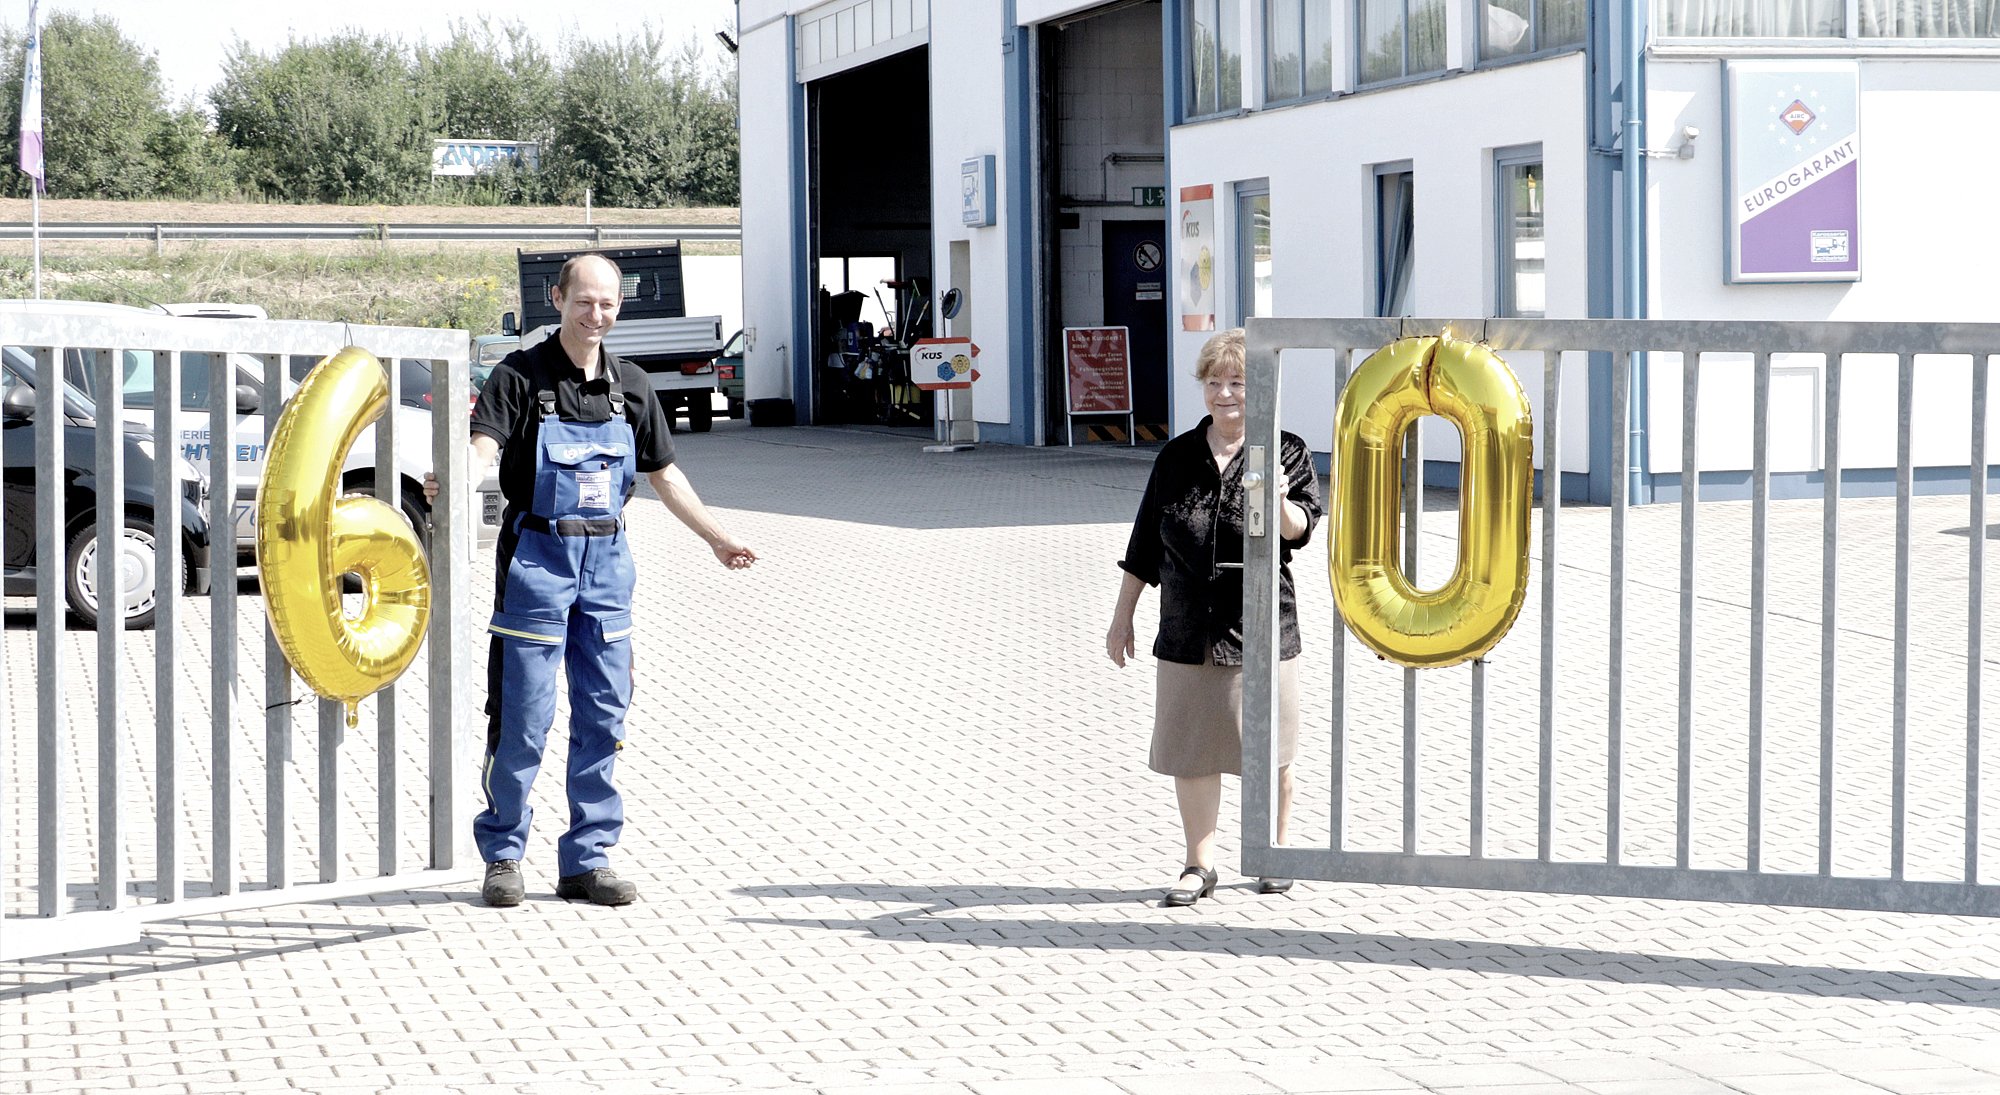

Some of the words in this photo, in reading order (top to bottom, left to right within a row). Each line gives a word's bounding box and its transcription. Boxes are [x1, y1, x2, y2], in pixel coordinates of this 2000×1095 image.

[1744, 141, 1854, 212] EUROGARANT
[180, 430, 210, 440] ERIE
[257, 346, 431, 705] 6
[1328, 336, 1533, 669] 0
